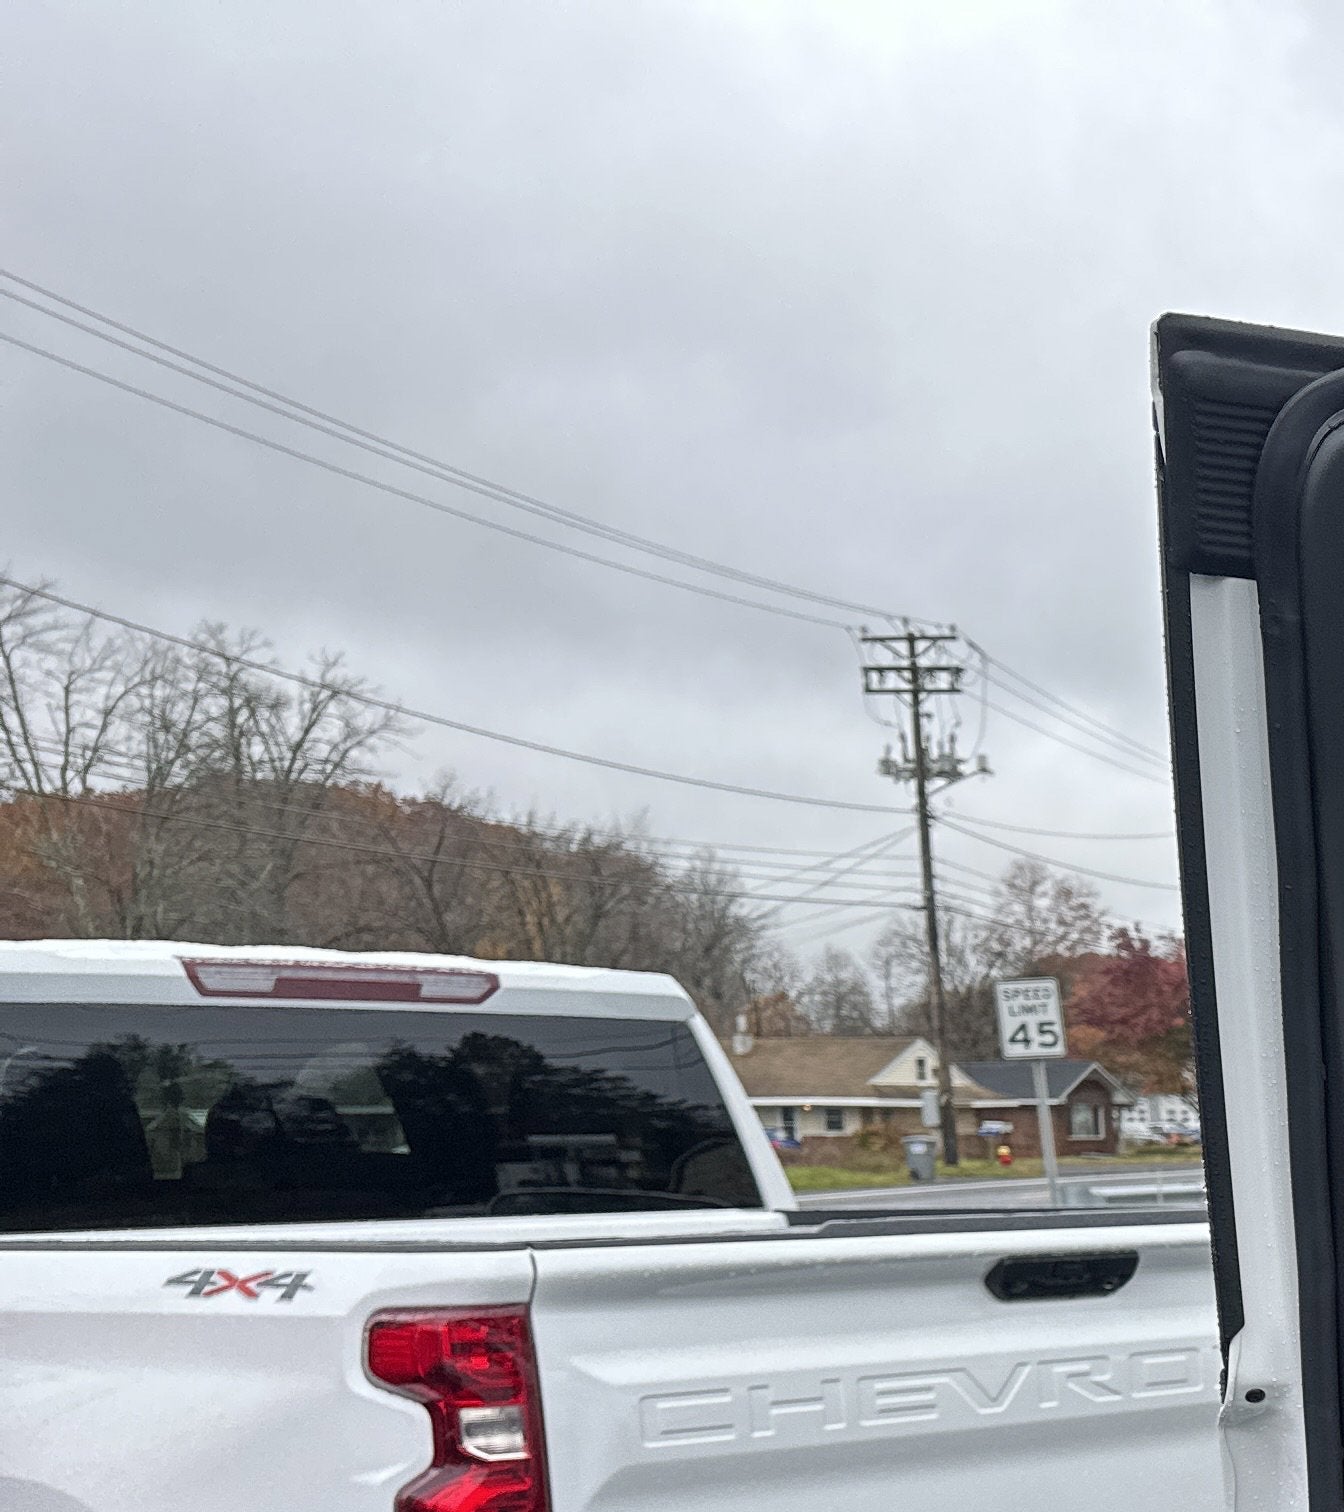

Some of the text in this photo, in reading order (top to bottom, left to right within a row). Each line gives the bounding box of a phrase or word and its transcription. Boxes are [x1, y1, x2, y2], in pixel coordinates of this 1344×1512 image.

[1002, 986, 1052, 1001] SPEED
[1007, 1002, 1049, 1017] LIMIT
[1008, 1020, 1059, 1050] 45
[638, 1346, 1218, 1449] CHEVRO
